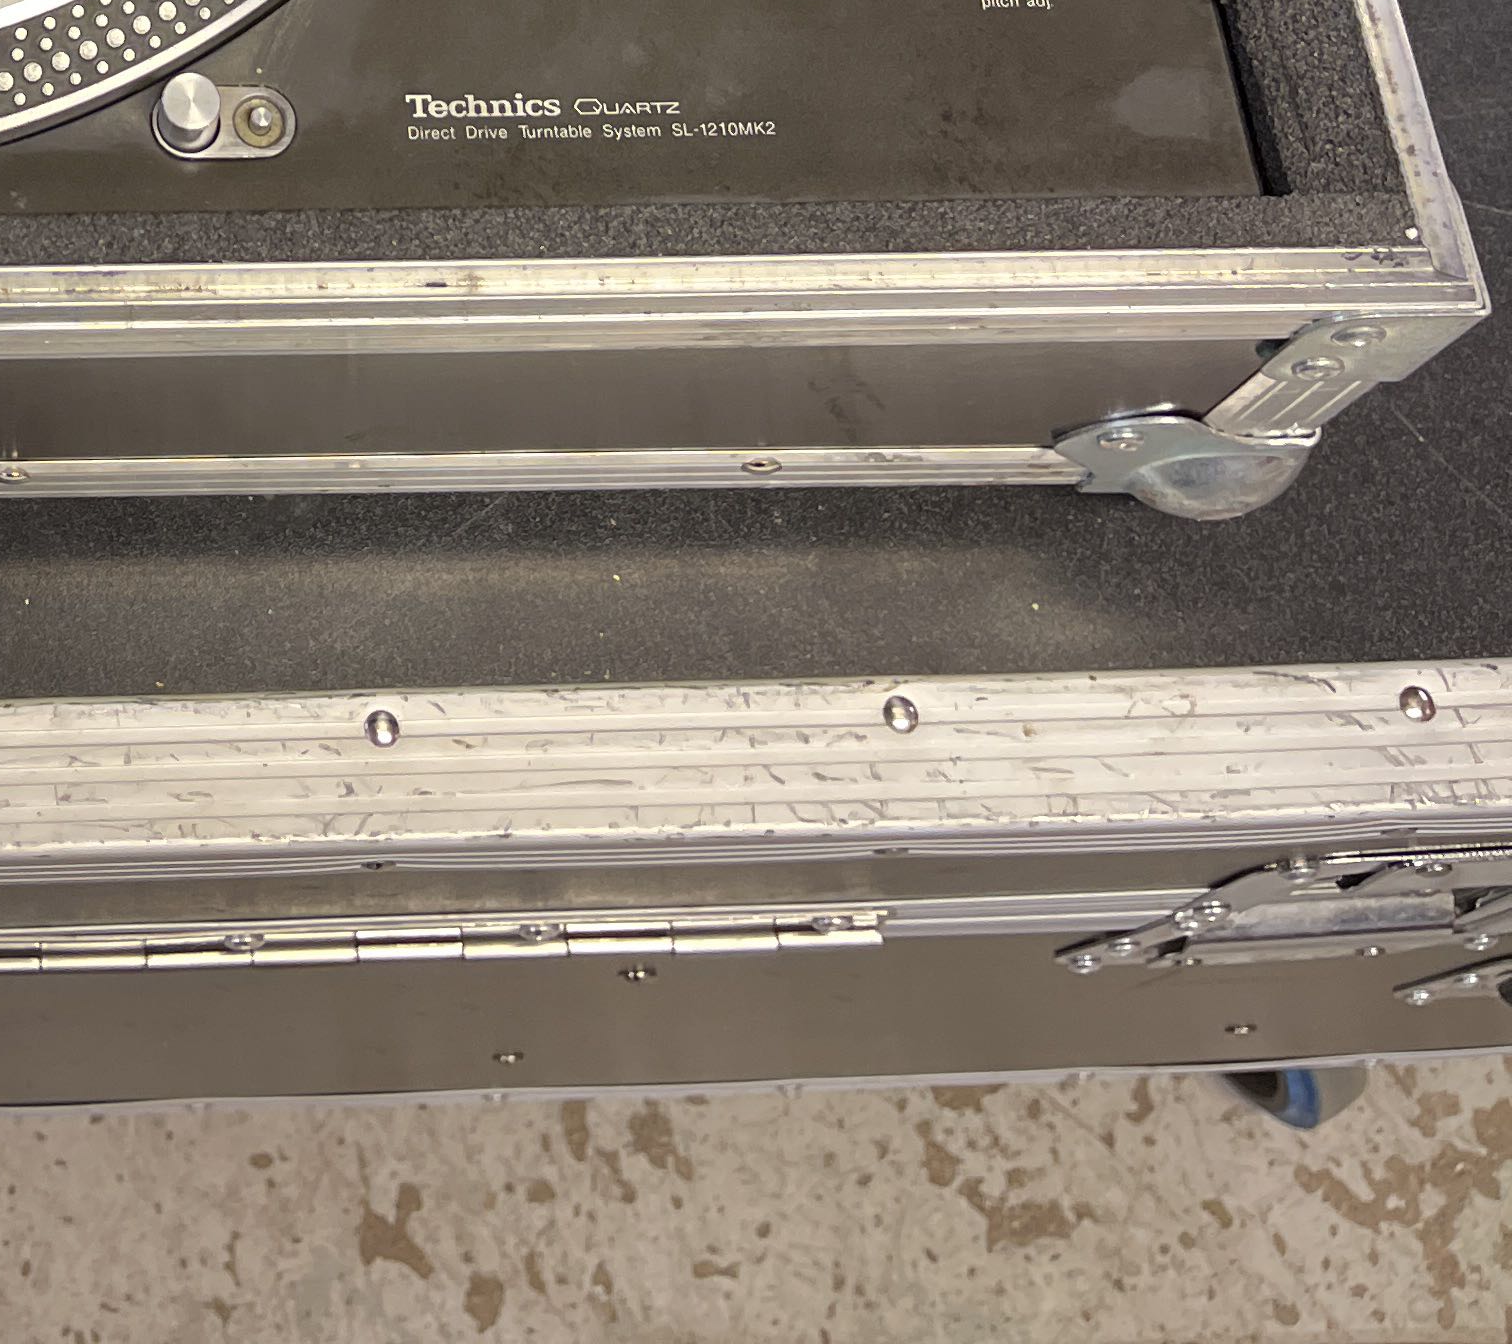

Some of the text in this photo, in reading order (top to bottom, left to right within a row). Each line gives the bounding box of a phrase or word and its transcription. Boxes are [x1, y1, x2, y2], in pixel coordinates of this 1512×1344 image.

[405, 91, 561, 119] Technics
[407, 120, 777, 141] Direct Drive Turntable System SL-1210MK2
